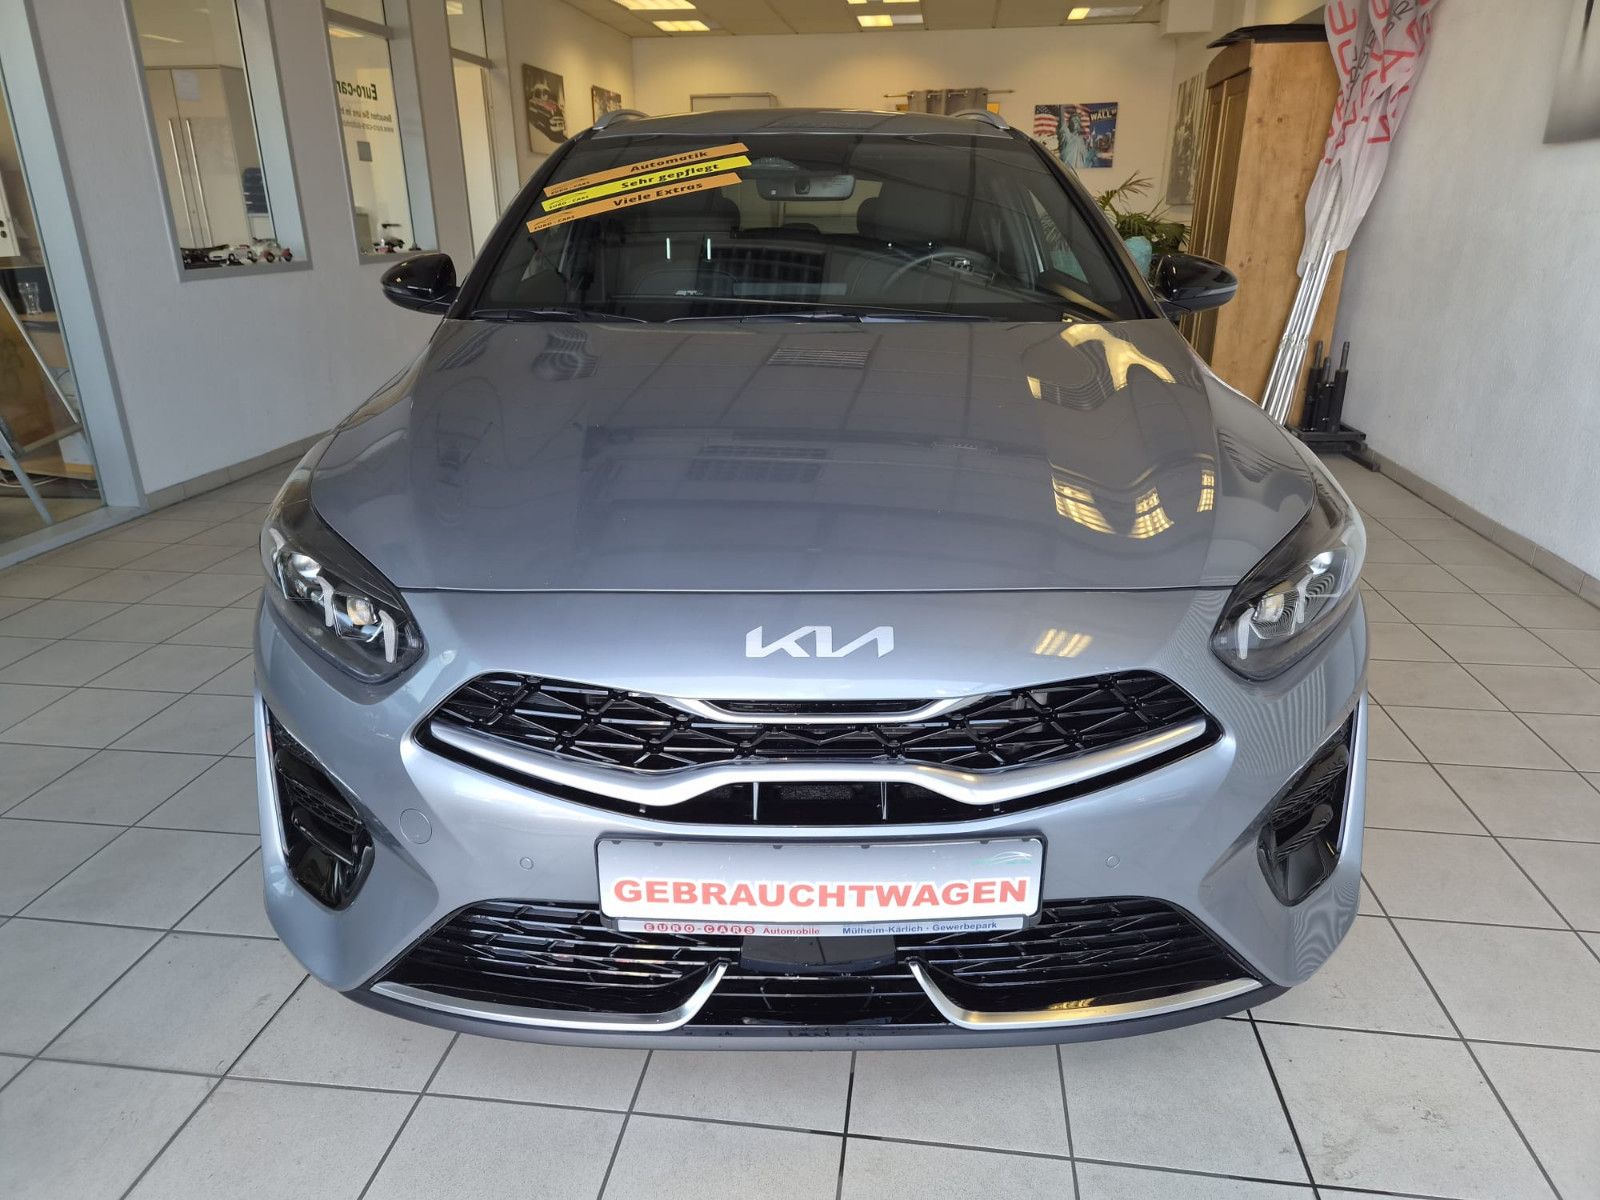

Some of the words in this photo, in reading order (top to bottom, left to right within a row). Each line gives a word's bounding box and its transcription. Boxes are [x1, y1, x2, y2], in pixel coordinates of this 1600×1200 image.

[1090, 109, 1112, 121] WALL
[630, 151, 708, 172] Automatik
[621, 175, 654, 189] Sehr
[658, 163, 720, 183] gepflegt
[613, 192, 651, 207] Viele
[656, 183, 703, 198] Extras
[745, 625, 895, 658] KIA
[613, 878, 1028, 909] GEBRAUCHTWAGEN
[763, 927, 820, 935] Automobile
[932, 921, 998, 933] Gewerbepark
